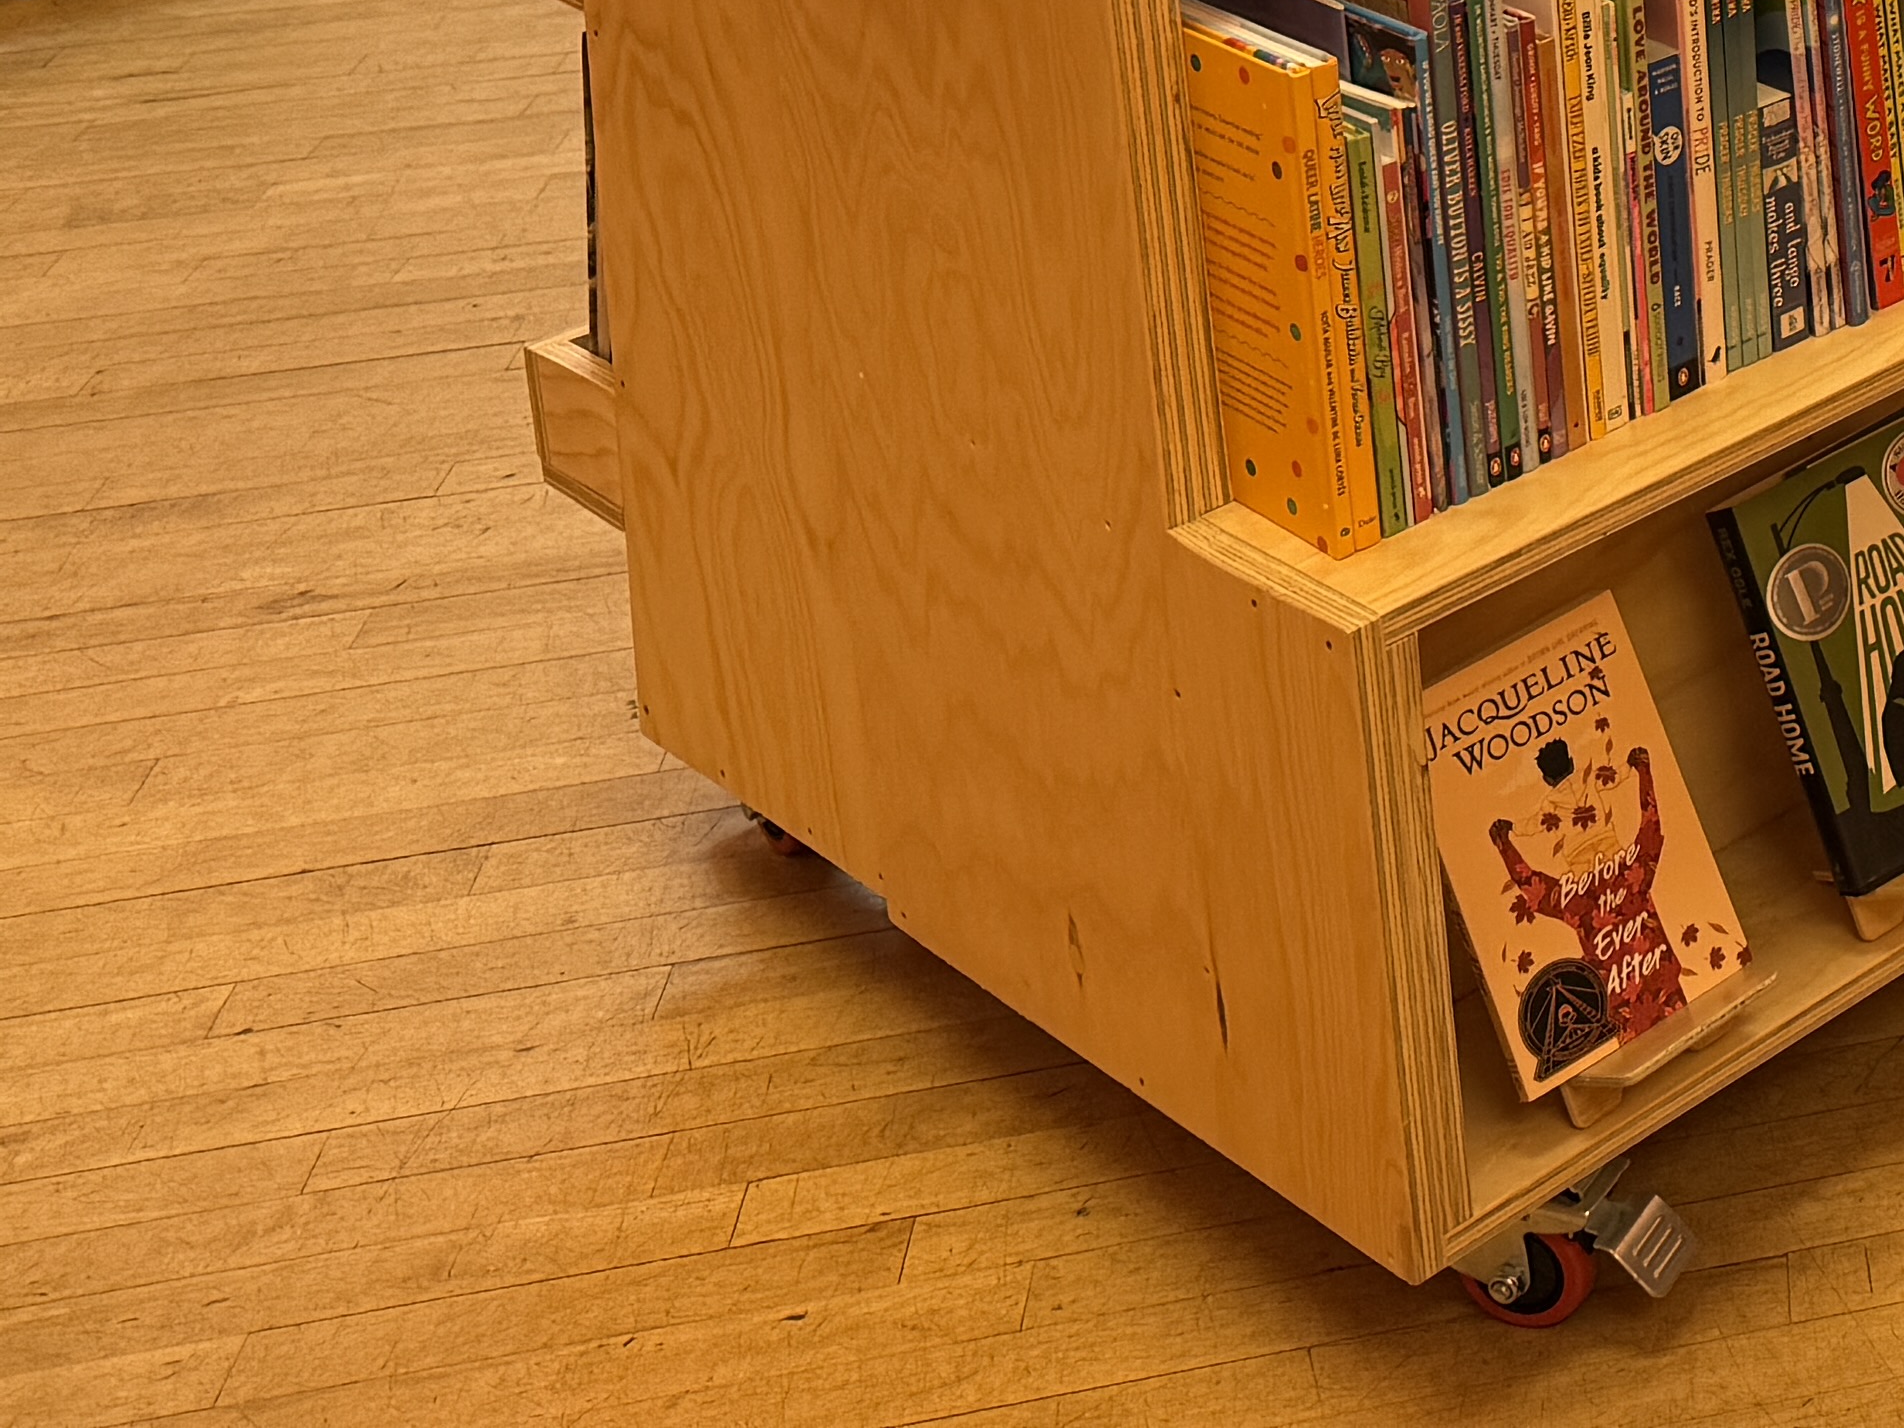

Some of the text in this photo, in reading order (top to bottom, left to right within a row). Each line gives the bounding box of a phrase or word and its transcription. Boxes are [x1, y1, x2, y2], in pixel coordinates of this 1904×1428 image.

[1632, 6, 1648, 79] LOVE
[1644, 195, 1661, 286] WORLD
[1425, 630, 1618, 762] JACQUELINE
[1452, 673, 1610, 776] WOODSON
[1558, 844, 1641, 906] Before
[1598, 883, 1626, 915] the
[1594, 912, 1649, 961] Ever
[1605, 944, 1668, 994] After
